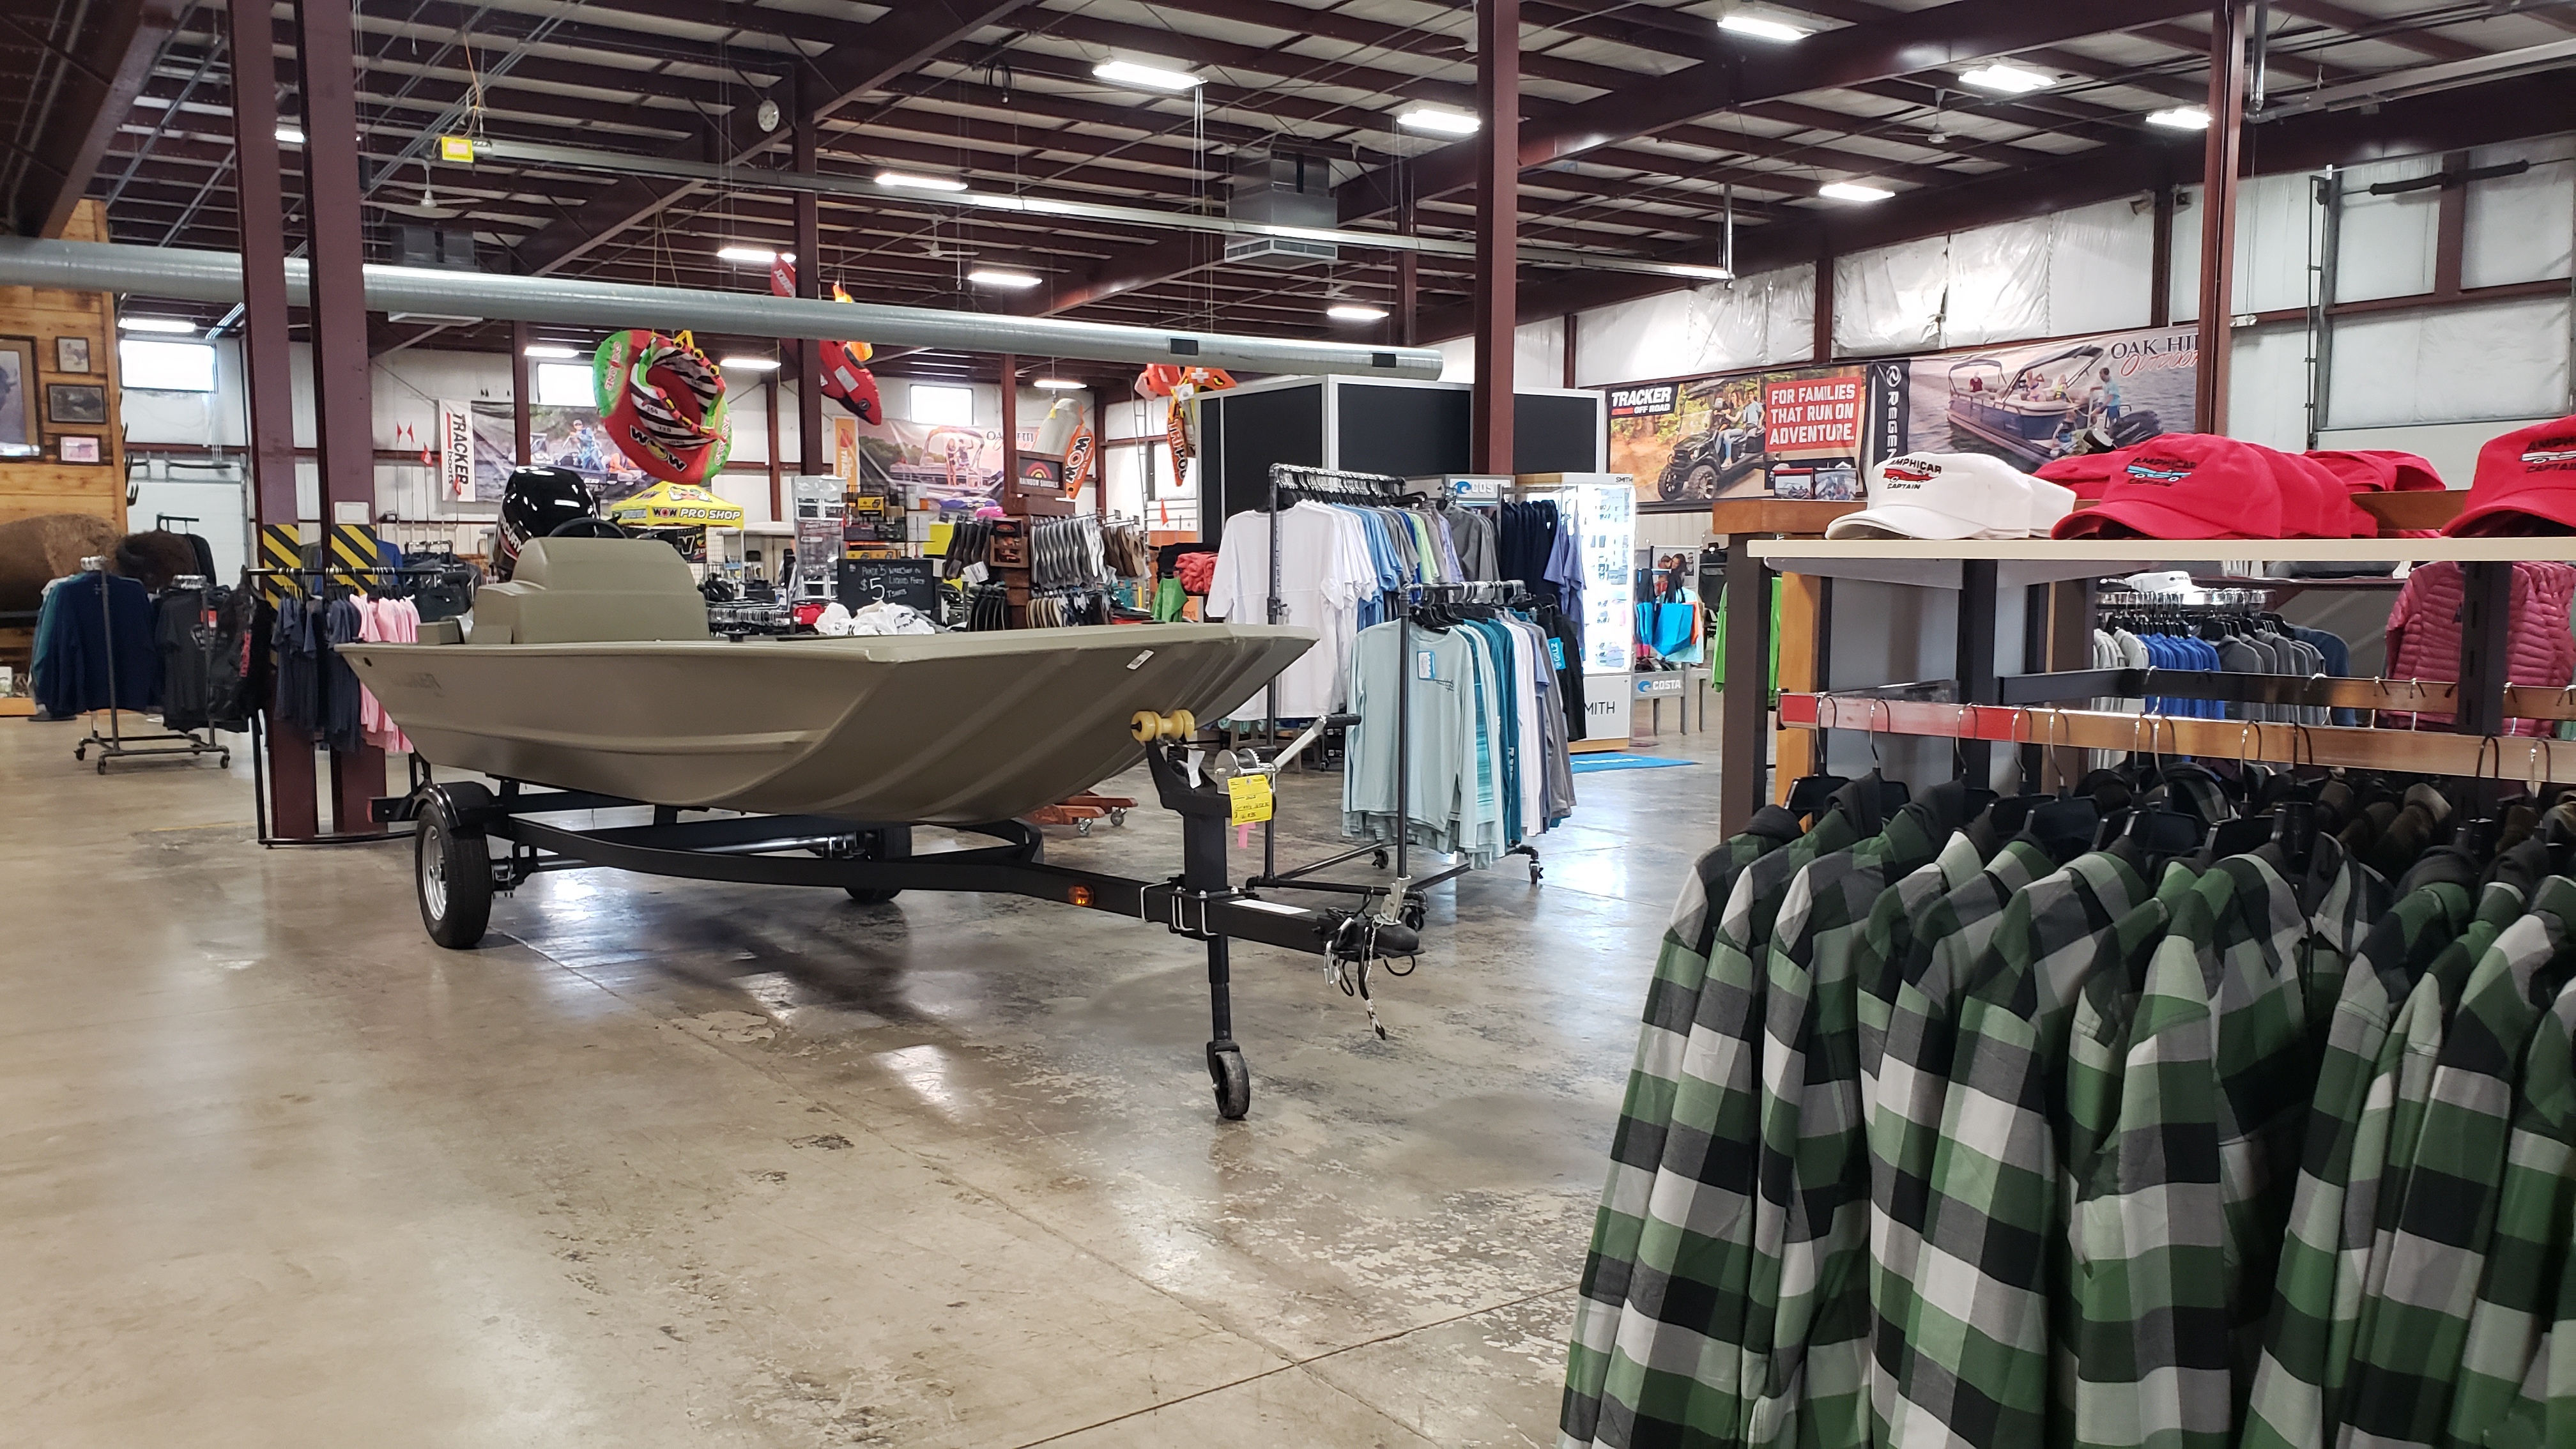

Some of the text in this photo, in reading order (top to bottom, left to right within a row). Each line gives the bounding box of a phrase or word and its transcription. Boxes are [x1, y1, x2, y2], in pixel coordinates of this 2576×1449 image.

[2111, 339, 2158, 359] OAK
[604, 341, 622, 391] CYCONE
[1611, 387, 1672, 407] TRACKER
[1771, 383, 1856, 406] FOR FAMILIES
[1634, 404, 1671, 415] OFF ROAD
[1770, 402, 1855, 424] THAT RUN ON
[986, 431, 1003, 441] OA
[1768, 422, 1855, 446] ADVENTURE.
[1887, 391, 1899, 460] REGEN
[452, 413, 469, 485] TRACKER
[630, 425, 687, 472] WOW
[714, 415, 731, 466] CYCONE
[1065, 436, 1092, 484] WOW
[1888, 458, 1942, 474] AMPHICAR
[1471, 483, 1498, 494] COST
[653, 508, 677, 518] WOW
[680, 508, 705, 519] PRO
[708, 509, 741, 521] SHOP
[1652, 679, 1681, 691] COSTA
[1584, 701, 1615, 716] MITH
